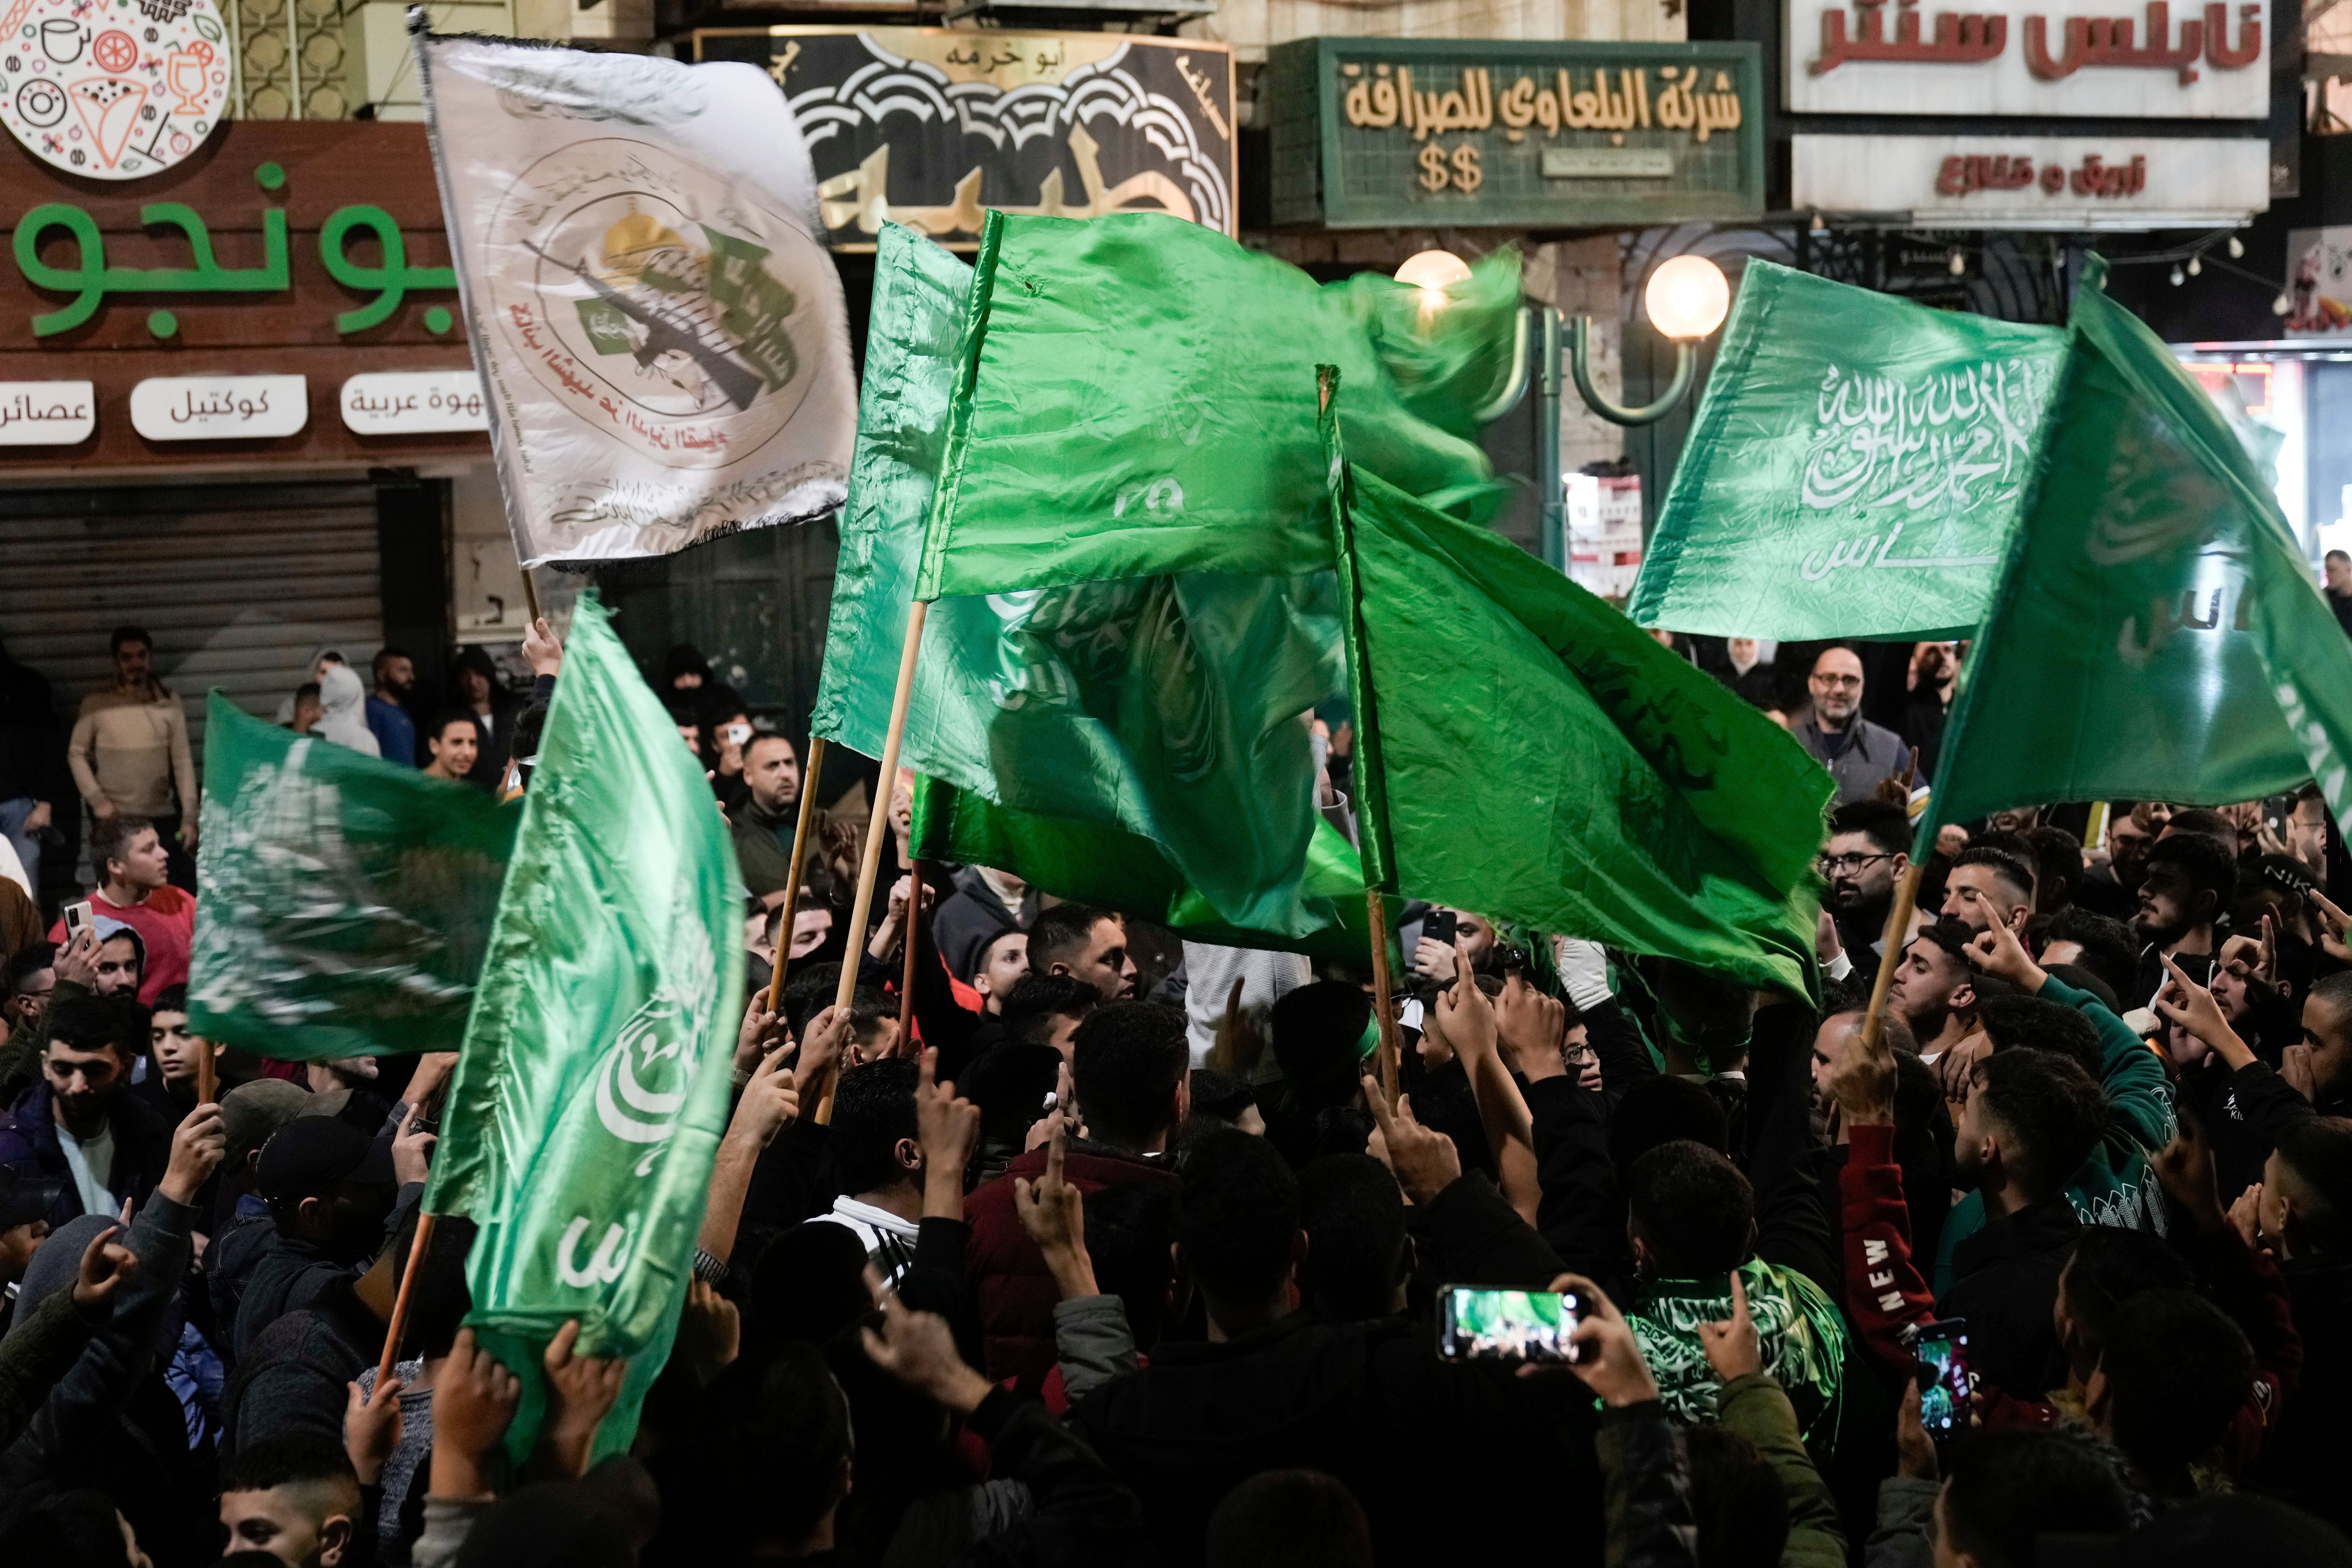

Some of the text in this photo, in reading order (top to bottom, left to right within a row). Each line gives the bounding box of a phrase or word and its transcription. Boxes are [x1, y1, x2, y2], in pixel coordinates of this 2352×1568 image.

[1035, 40, 1066, 75] أبو
[1805, 0, 2261, 87] نابلس سنتر
[1343, 63, 1743, 146] شركة البلعاوي للصرافة
[0, 394, 87, 428] عصائر
[170, 389, 270, 424] كوكتيل
[350, 386, 486, 420] هوة عربية
[2264, 864, 2320, 900] NIK
[1863, 1240, 1906, 1312] NEW
